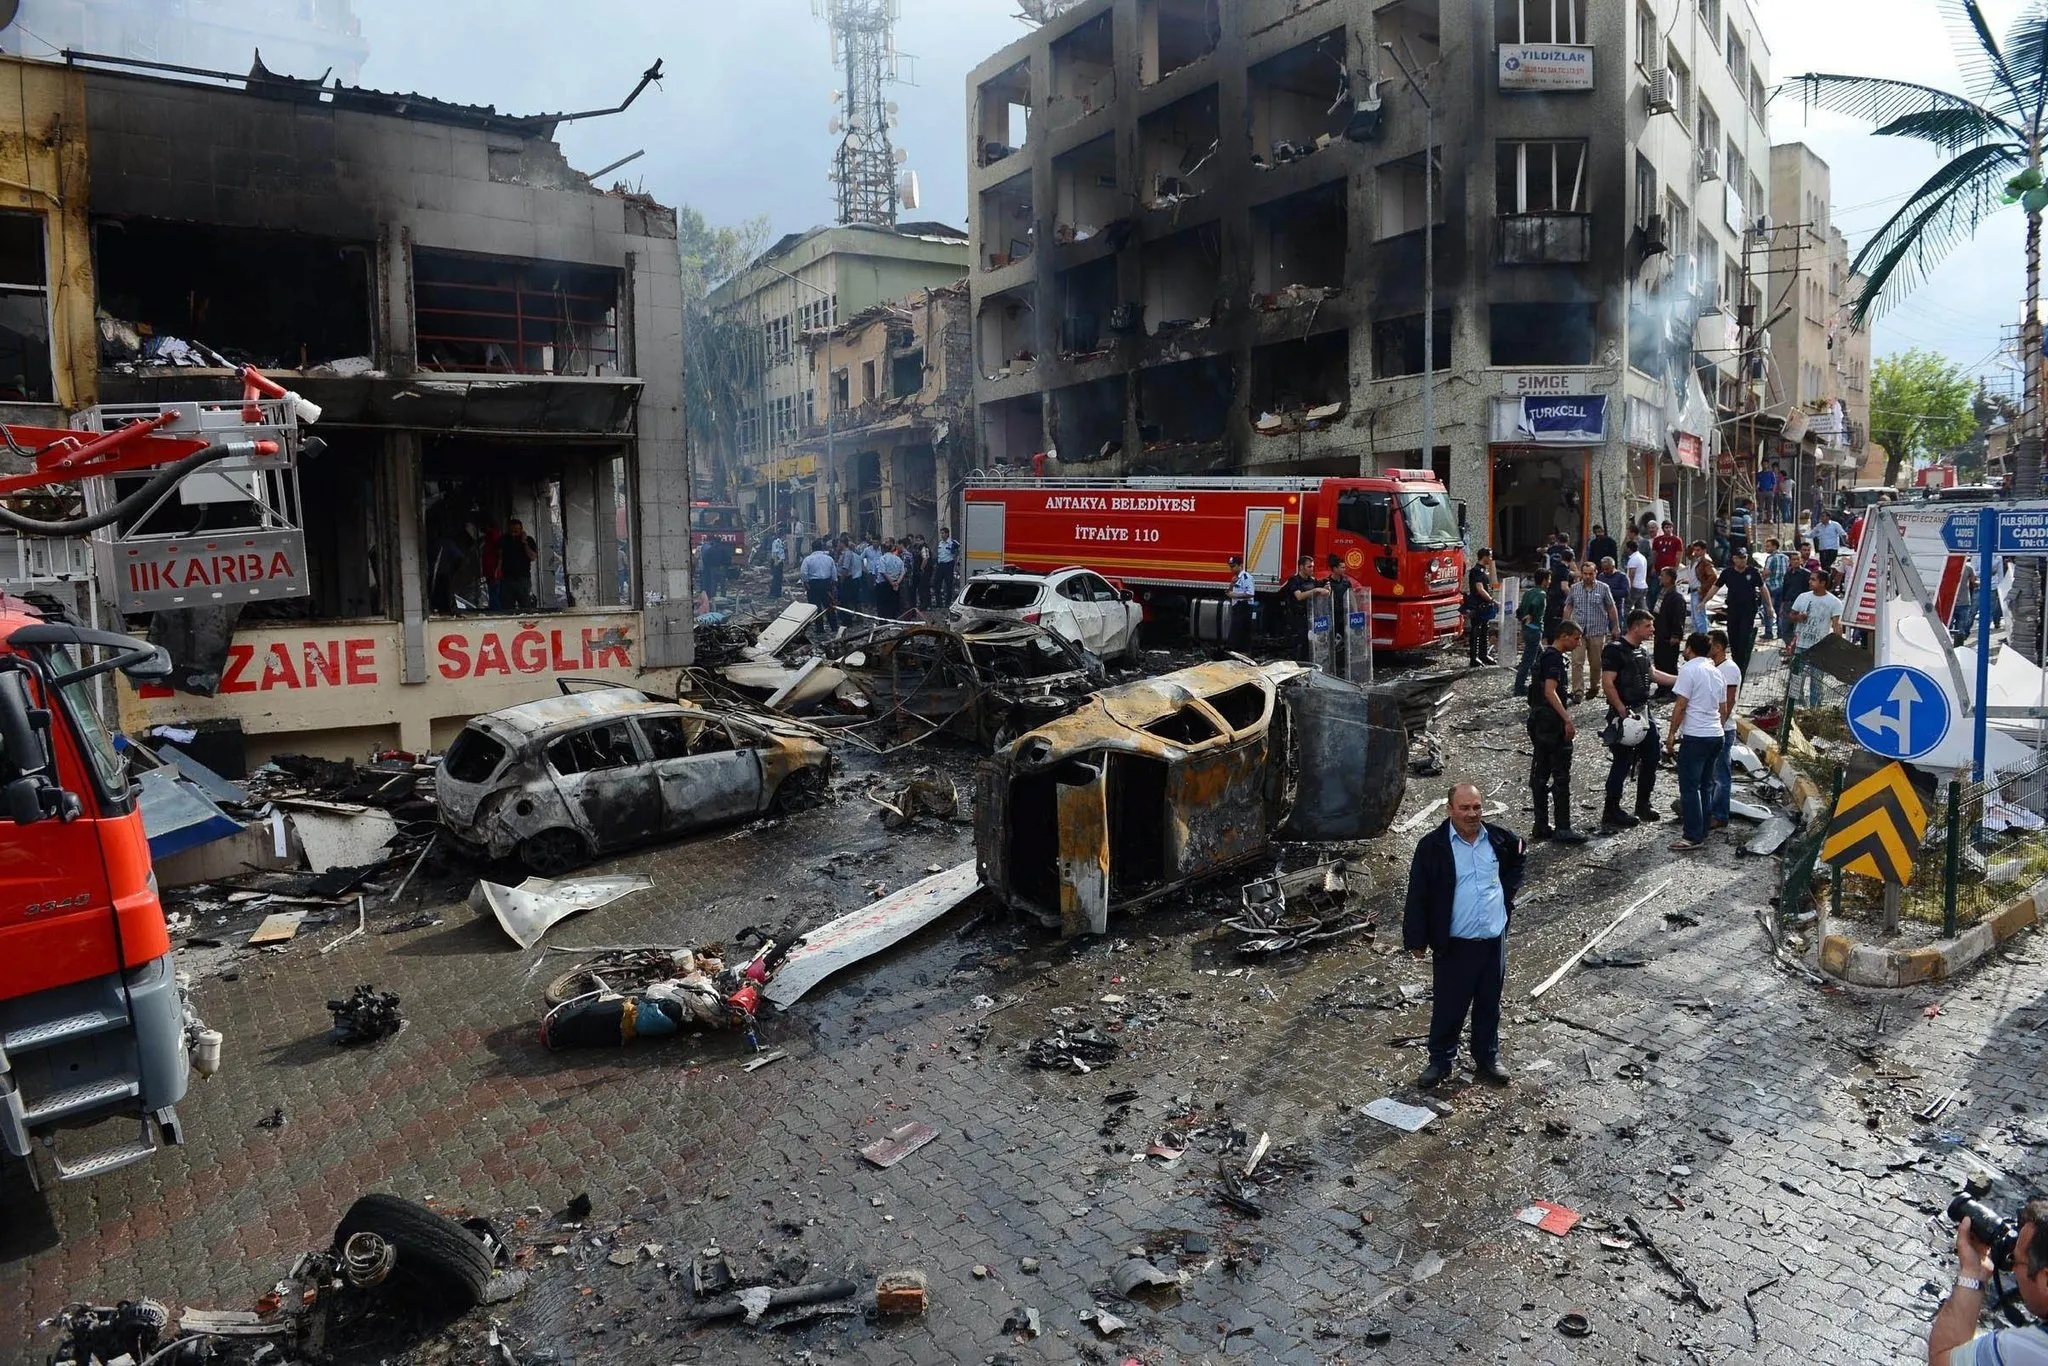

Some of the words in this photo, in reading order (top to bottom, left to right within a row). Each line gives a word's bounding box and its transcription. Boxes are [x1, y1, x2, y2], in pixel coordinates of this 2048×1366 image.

[1521, 51, 1585, 62] YILDIZLAR
[1529, 405, 1587, 420] TURKCELL
[1045, 497, 1107, 510] ANTAKYA
[1111, 495, 1196, 512] BELEDİYESİ
[1074, 524, 1129, 541] İTFAİYE
[1134, 529, 1160, 542] 110
[438, 622, 633, 680] SAĞLIK
